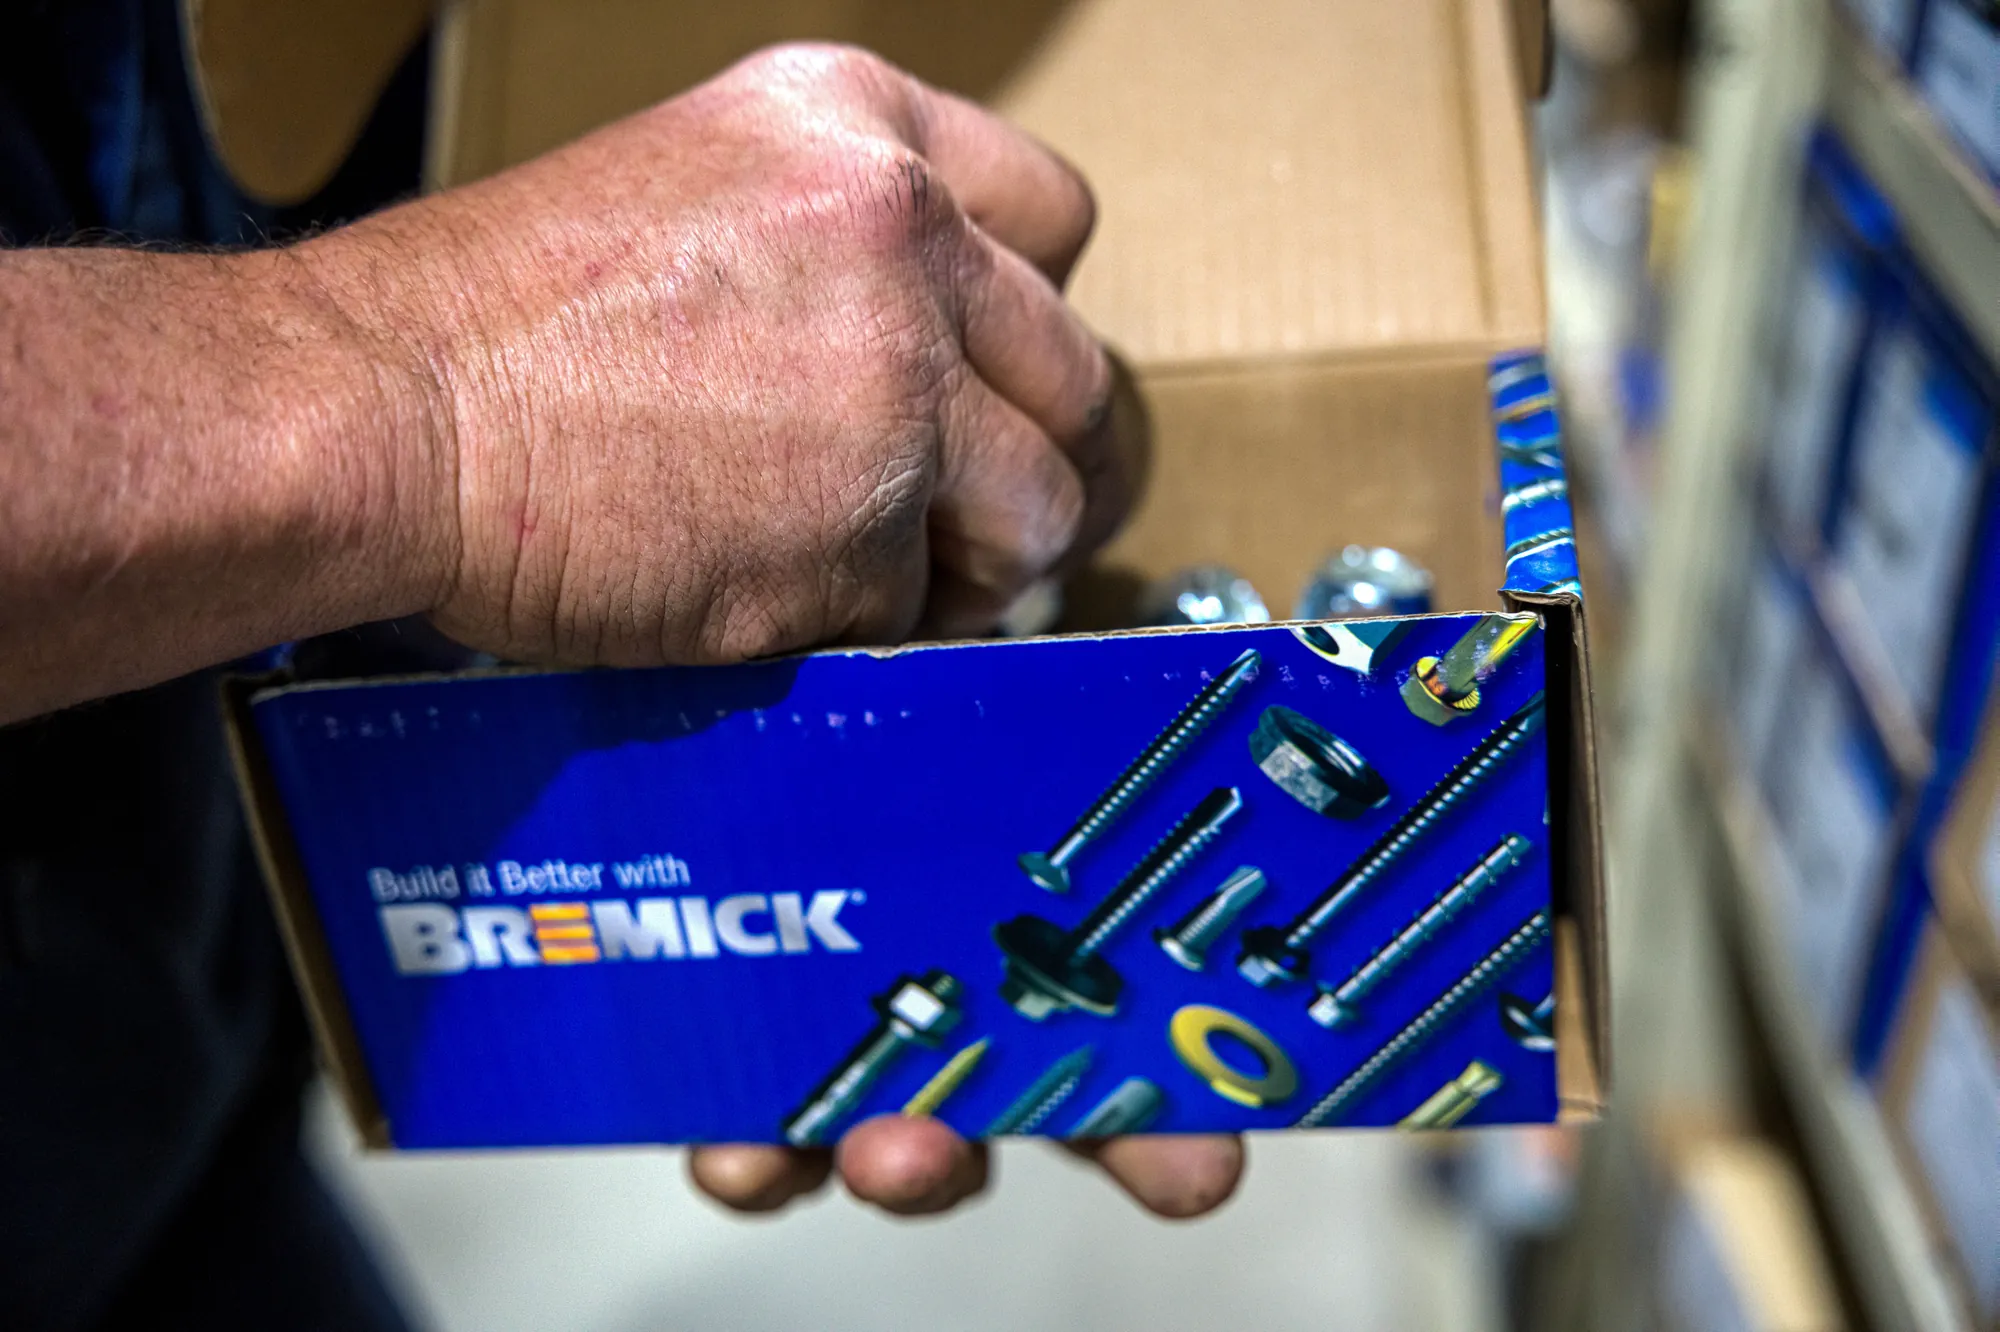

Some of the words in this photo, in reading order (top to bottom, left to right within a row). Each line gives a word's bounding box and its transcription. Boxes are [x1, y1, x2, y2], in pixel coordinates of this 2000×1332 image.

[369, 865, 460, 901] Build
[465, 863, 496, 897] it
[497, 858, 604, 895] Better
[613, 853, 691, 889] with
[379, 889, 862, 976] BREMICK
